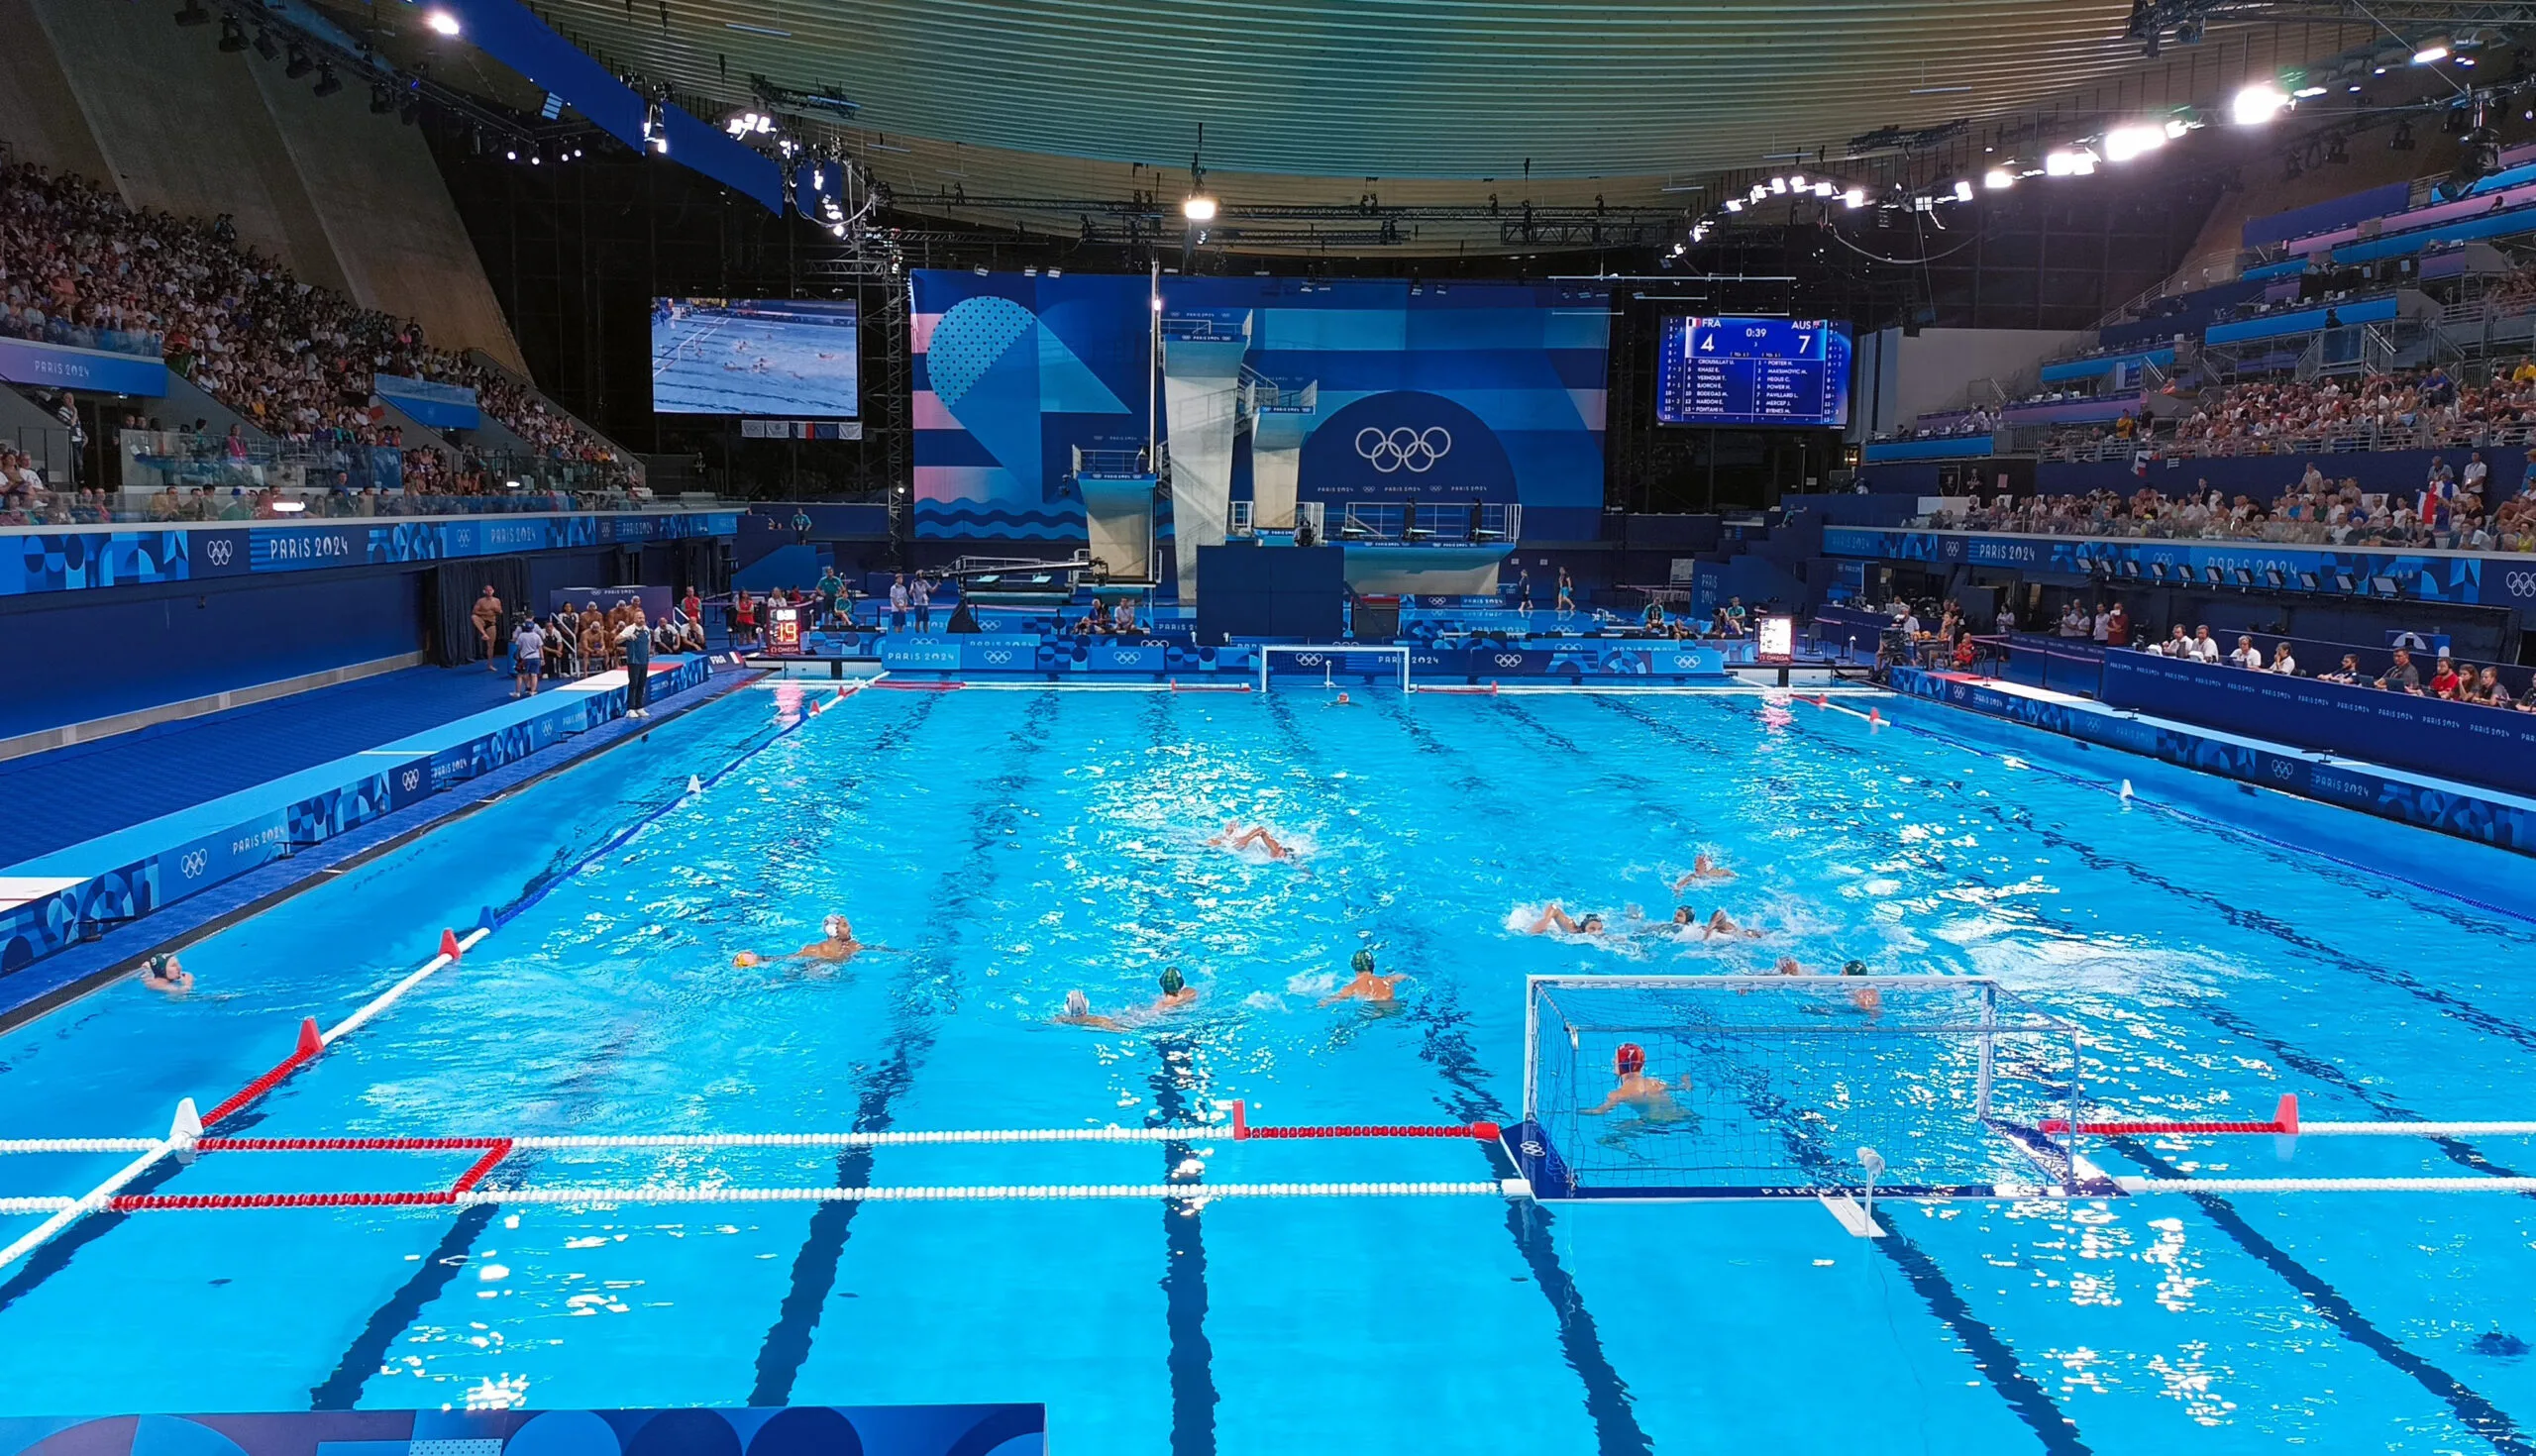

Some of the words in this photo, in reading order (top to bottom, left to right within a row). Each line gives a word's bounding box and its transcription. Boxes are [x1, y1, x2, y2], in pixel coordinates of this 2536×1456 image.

[1702, 319, 1721, 327] FRA
[1791, 320, 1811, 329] AUS
[1746, 328, 1766, 337] 0:39
[1700, 333, 1714, 352] 4
[1799, 335, 1810, 354] 7
[315, 535, 348, 557] 2024
[2009, 545, 2035, 561] 2024
[780, 623, 796, 642] 19
[710, 655, 726, 664] FRA
[888, 652, 920, 661] PARIS
[925, 652, 954, 661] 2024
[2315, 775, 2342, 791] PARIS
[2344, 782, 2369, 797] 2024
[233, 834, 259, 855] PARIS
[262, 826, 285, 844] 2024
